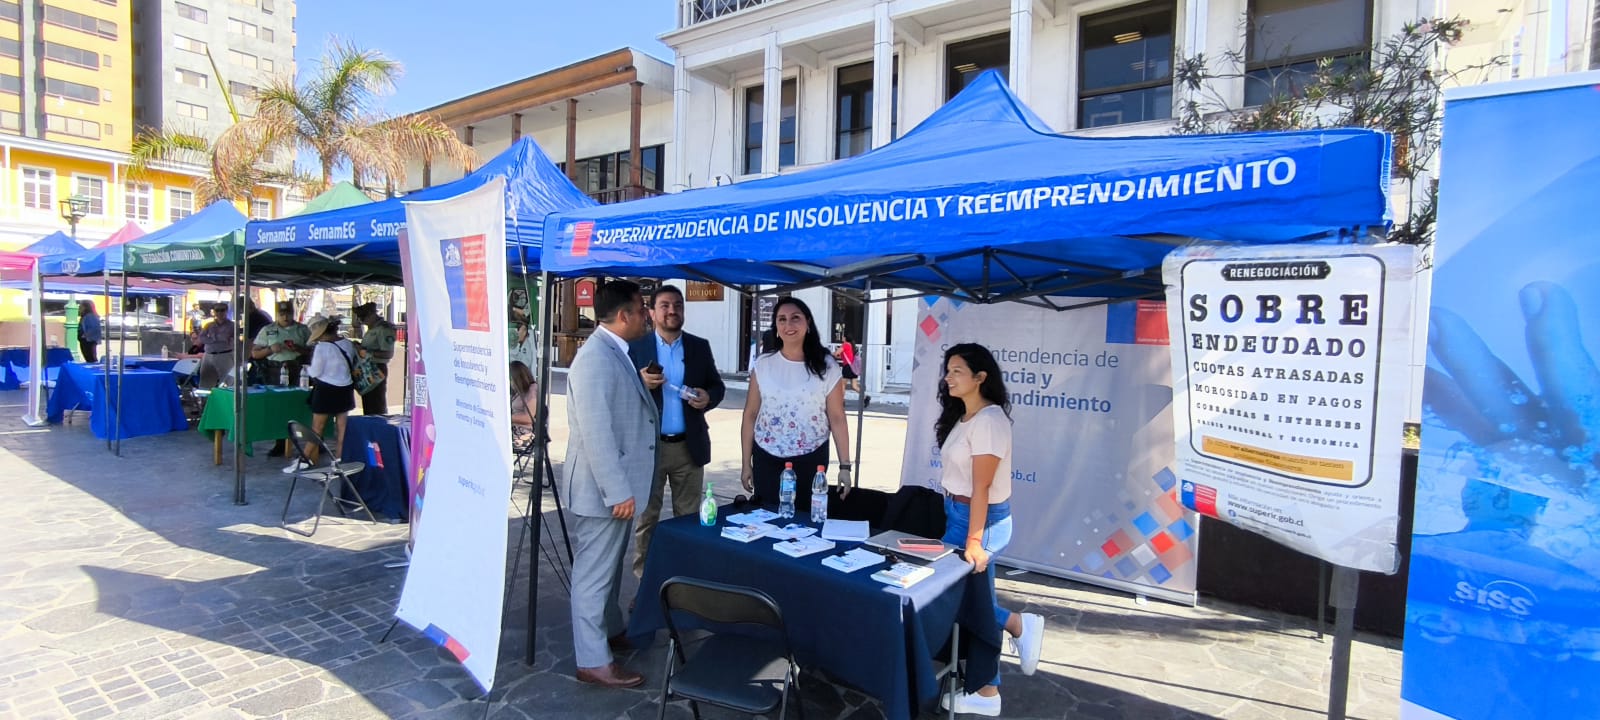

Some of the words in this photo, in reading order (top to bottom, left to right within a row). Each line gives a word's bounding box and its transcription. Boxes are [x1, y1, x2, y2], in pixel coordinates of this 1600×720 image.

[594, 215, 749, 244] SUPERINTENDENCIA
[754, 211, 780, 232] DE
[784, 198, 928, 229] INSOLVENCIA
[936, 195, 953, 217] Y
[957, 156, 1297, 216] REEMPRENDIMIENTO
[257, 226, 296, 243] SernamEG
[308, 221, 356, 240] SernamEG
[1230, 265, 1319, 278] RENEGOCIACIÓN
[1189, 293, 1369, 326] SOBRE
[940, 344, 1088, 366] Sntendencia
[1095, 350, 1119, 368] de
[1191, 333, 1366, 358] ENDEUDADO
[1041, 372, 1053, 389] y
[1193, 361, 1245, 377] CUOTAS
[1251, 367, 1364, 385] ATRASADAS
[1194, 383, 1269, 402] MOROSIDAD
[1277, 394, 1299, 404] EN
[1308, 396, 1362, 409] PAGOS
[1278, 415, 1361, 430] INTERESES
